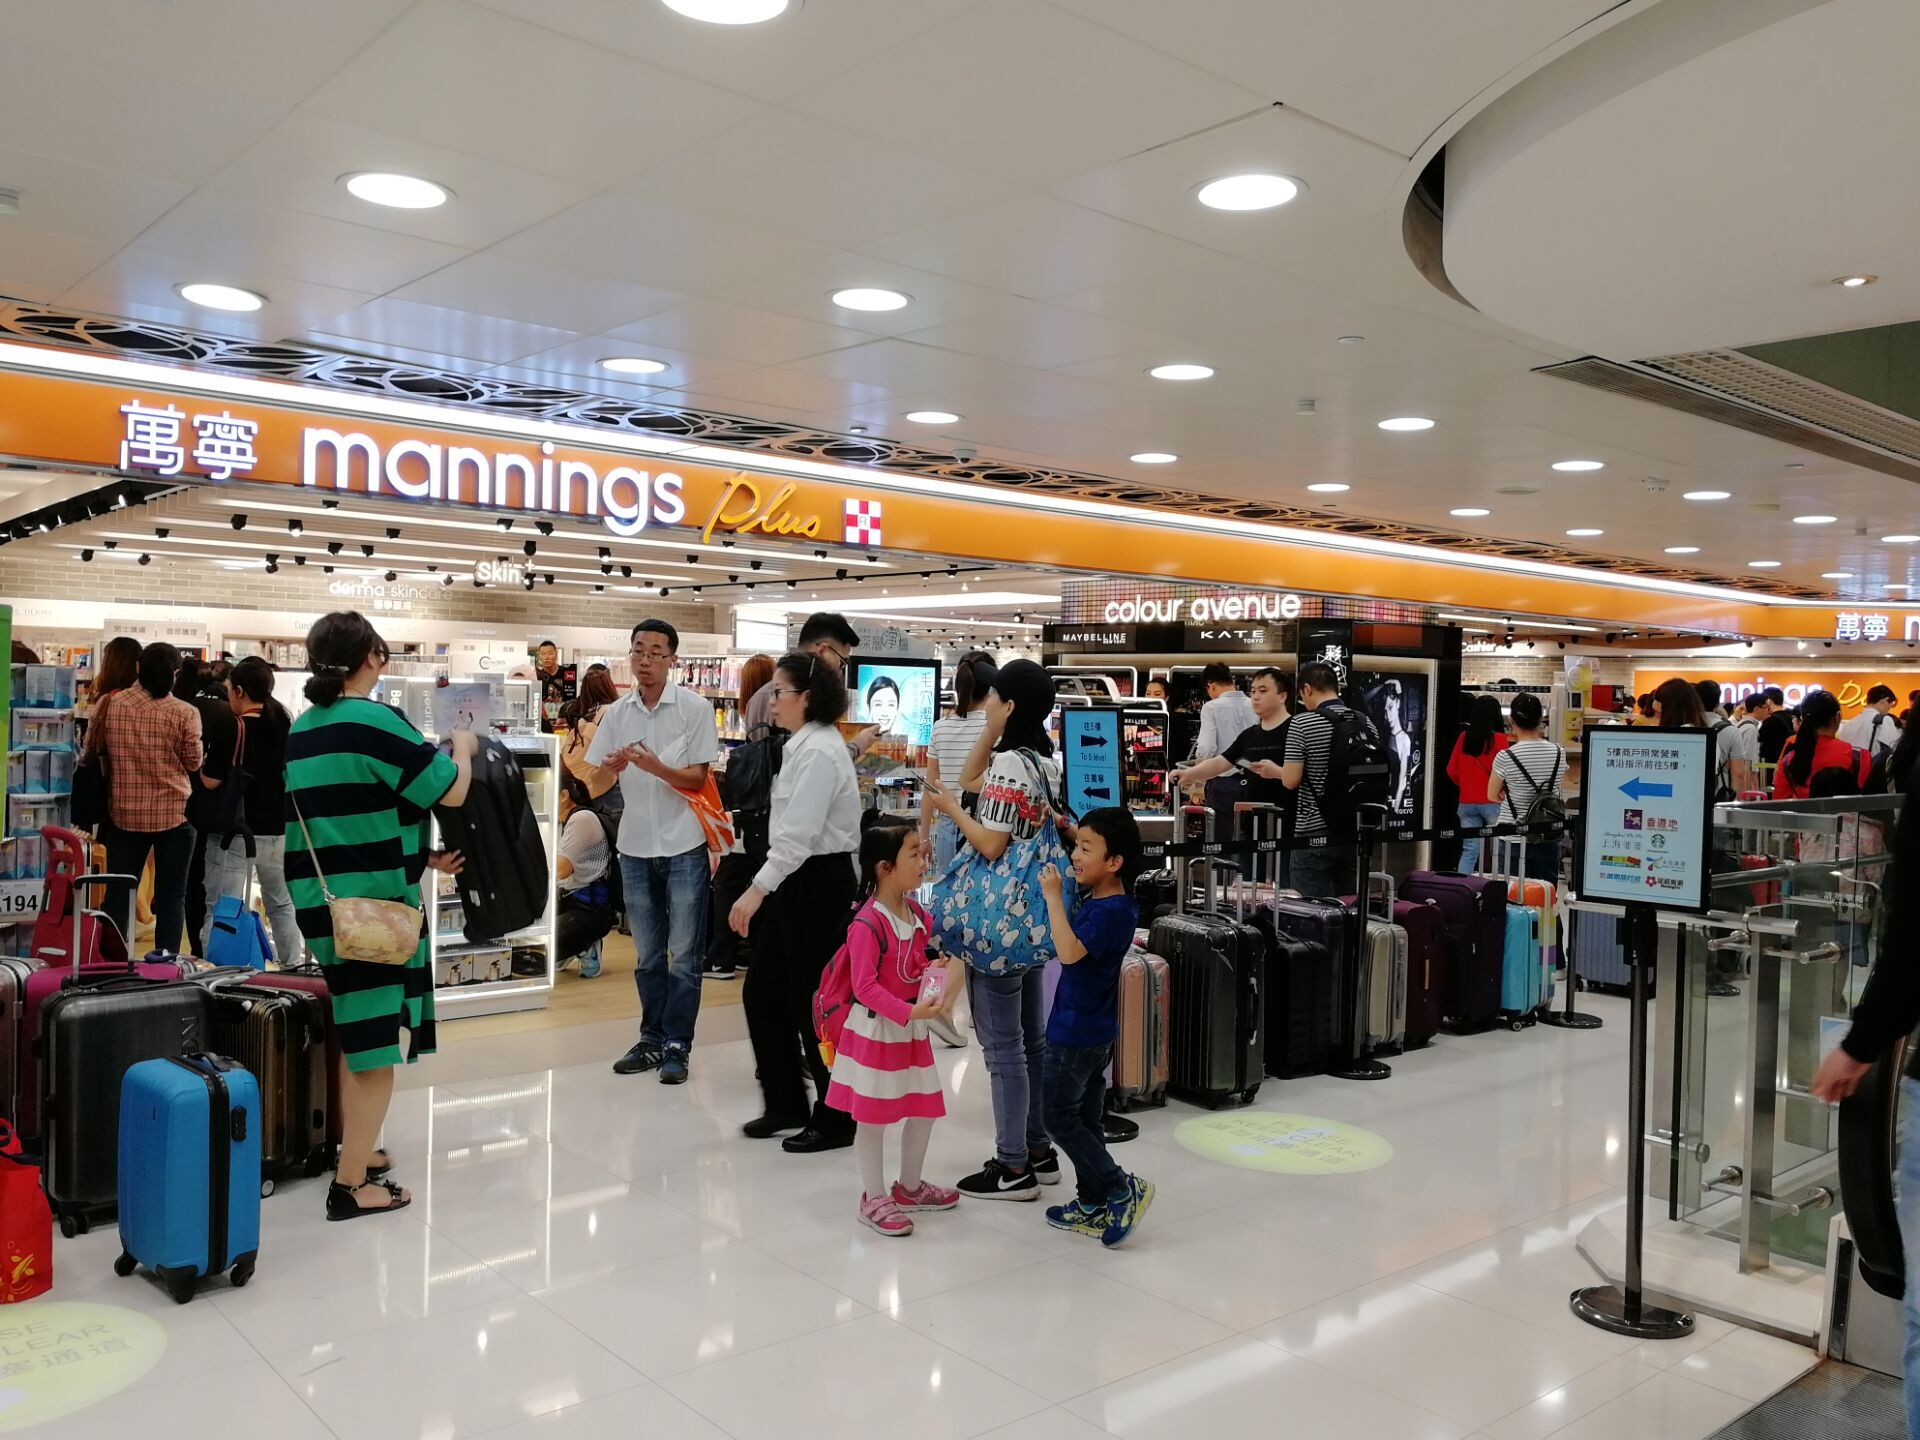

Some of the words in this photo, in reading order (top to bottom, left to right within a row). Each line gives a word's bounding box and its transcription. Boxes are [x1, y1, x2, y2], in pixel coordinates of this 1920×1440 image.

[119, 399, 260, 481] 萬寧
[302, 427, 686, 537] mannings
[701, 471, 822, 544] Plus
[328, 580, 385, 597] derma
[1104, 595, 1184, 623] colour
[1190, 594, 1302, 621] avenue
[1062, 633, 1126, 642] MAYBELLINE
[1201, 630, 1265, 639] KATE
[1836, 613, 1890, 641] 萬寧
[1094, 753, 1107, 761] level
[1, 1324, 113, 1357] LEAR
